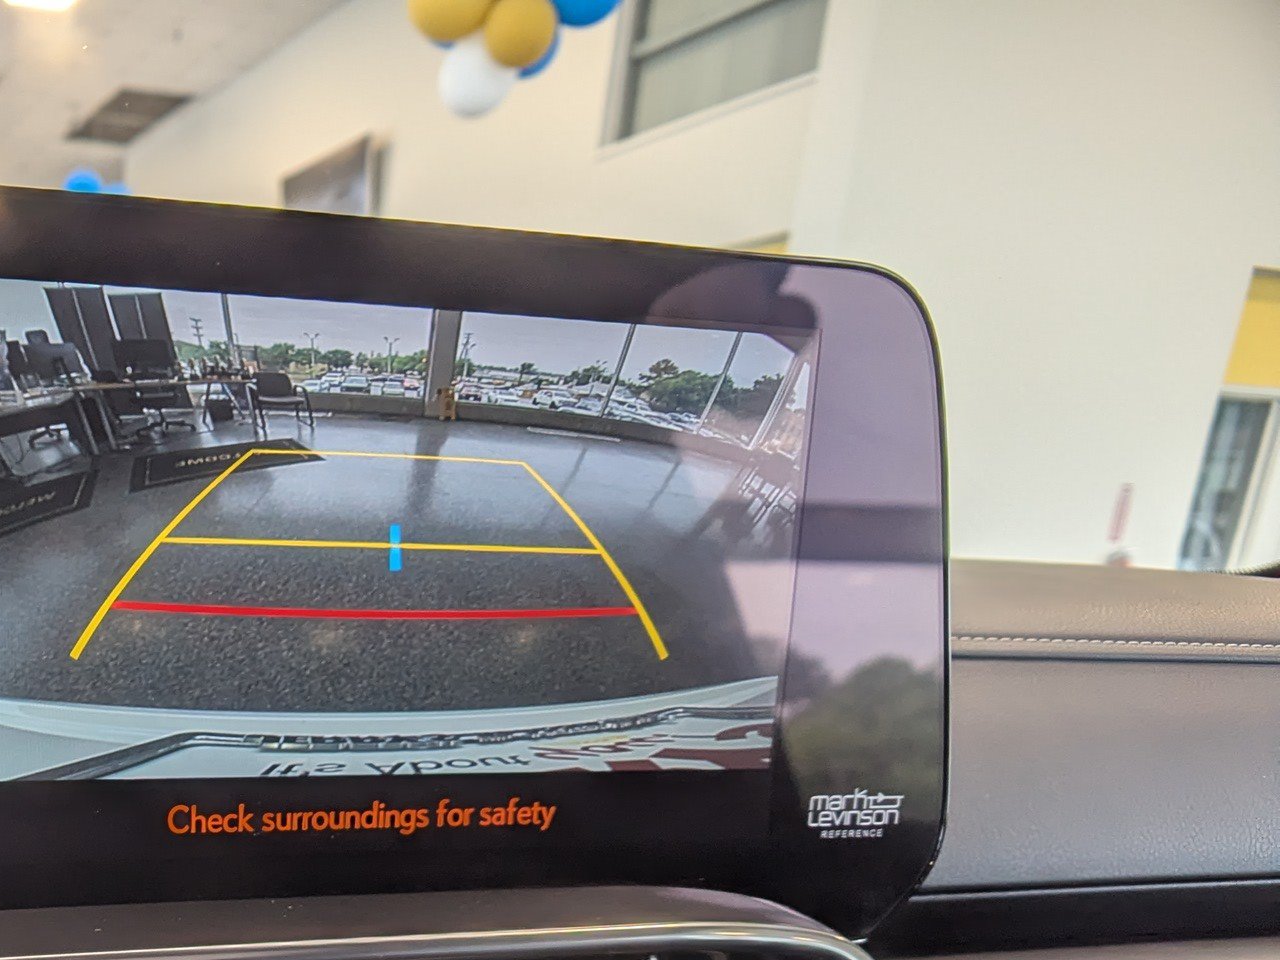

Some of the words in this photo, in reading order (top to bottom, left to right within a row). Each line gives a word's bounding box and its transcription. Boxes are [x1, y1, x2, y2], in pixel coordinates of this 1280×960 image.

[166, 804, 254, 834] Check
[261, 800, 430, 835] surroundings
[436, 798, 472, 828] for
[479, 797, 558, 831] safety
[820, 828, 884, 839] REFERENCE
